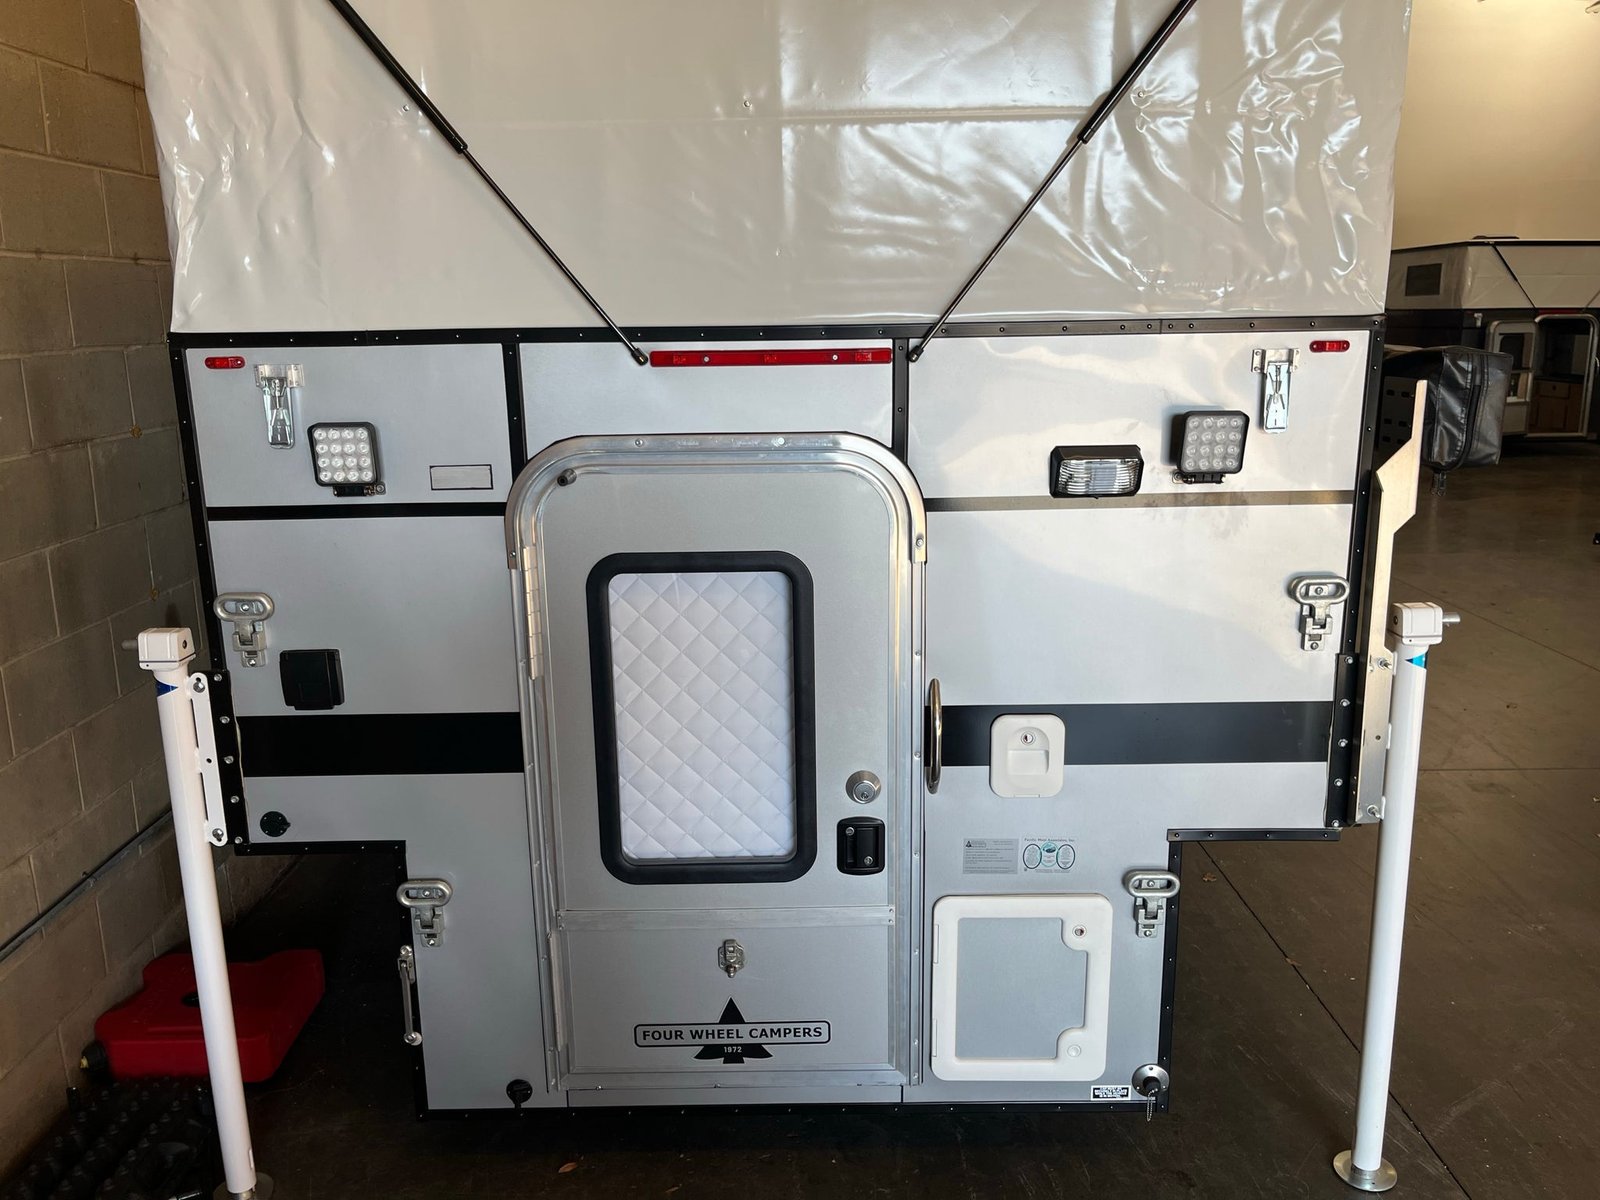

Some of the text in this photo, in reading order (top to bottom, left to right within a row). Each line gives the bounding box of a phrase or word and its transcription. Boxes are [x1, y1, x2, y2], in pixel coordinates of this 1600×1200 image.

[642, 1026, 823, 1041] FOUR WHEEL CAMPERS
